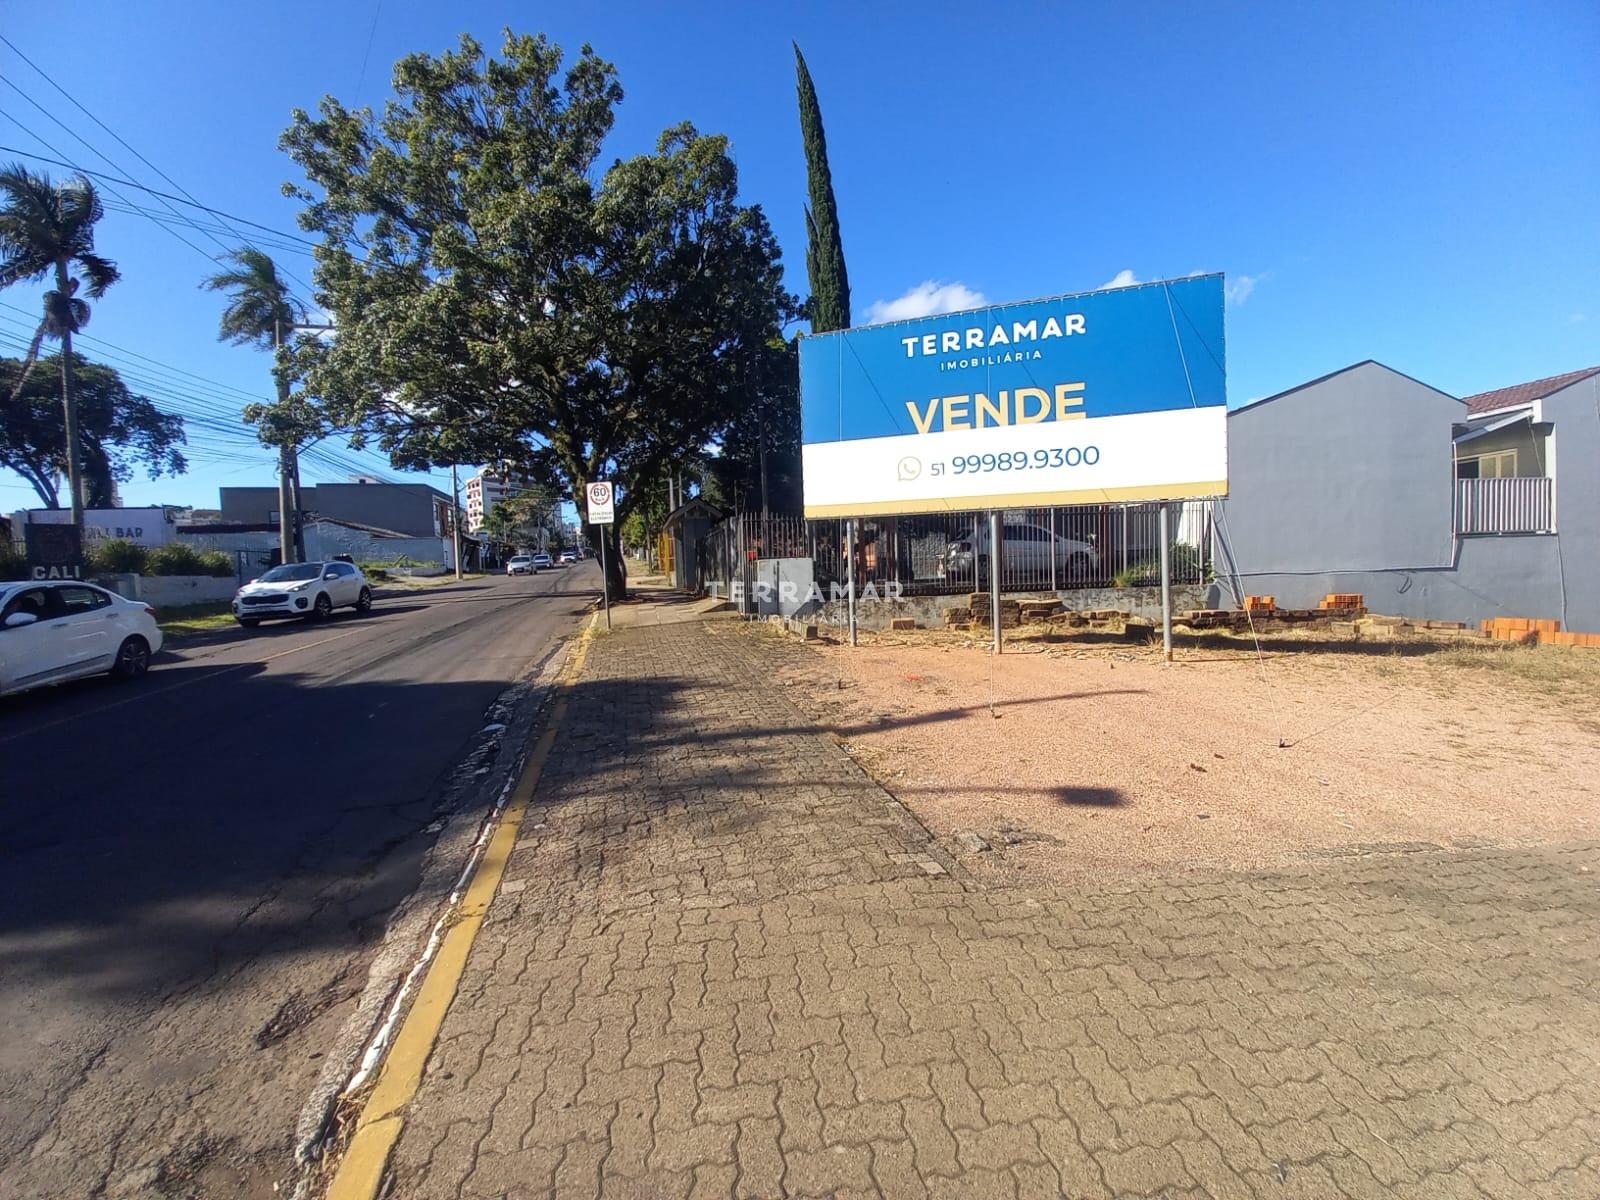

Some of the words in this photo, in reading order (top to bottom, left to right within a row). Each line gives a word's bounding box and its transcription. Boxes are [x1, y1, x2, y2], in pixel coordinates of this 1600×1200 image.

[902, 314, 1087, 358] TERRAMAR
[941, 350, 1042, 371] IMOBILIÁRIA
[905, 382, 1088, 434] VENDE
[931, 462, 945, 476] 51
[952, 445, 1100, 475] 99989.9300
[594, 487, 606, 497] 60
[116, 527, 143, 538] BAR
[32, 565, 80, 579] CALI
